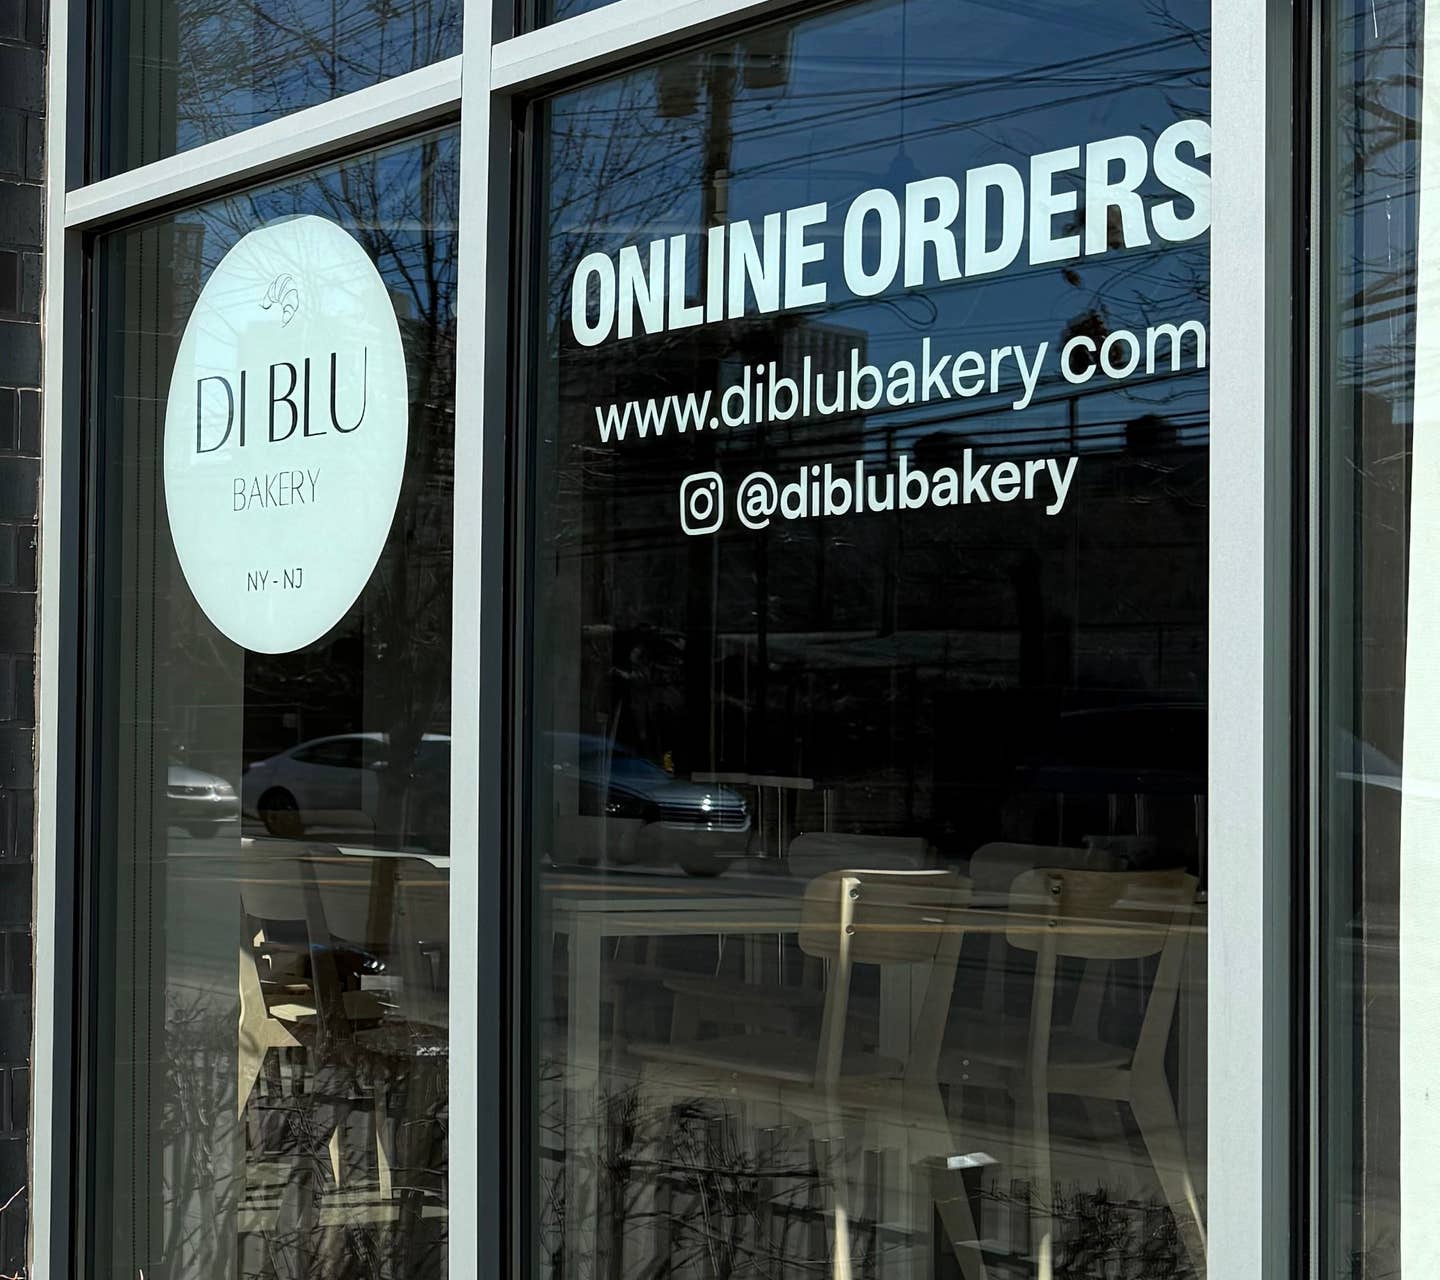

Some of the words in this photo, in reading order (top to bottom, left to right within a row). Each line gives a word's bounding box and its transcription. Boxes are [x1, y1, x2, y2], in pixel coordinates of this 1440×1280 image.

[571, 201, 827, 346] ONLINE
[843, 120, 1212, 297] ORDERS
[195, 370, 247, 454] DI
[268, 345, 368, 443] BLU
[233, 467, 321, 512] BAKERY
[736, 448, 1079, 528] @diblubakery
[247, 569, 269, 592] NY
[283, 567, 303, 590] NJ
